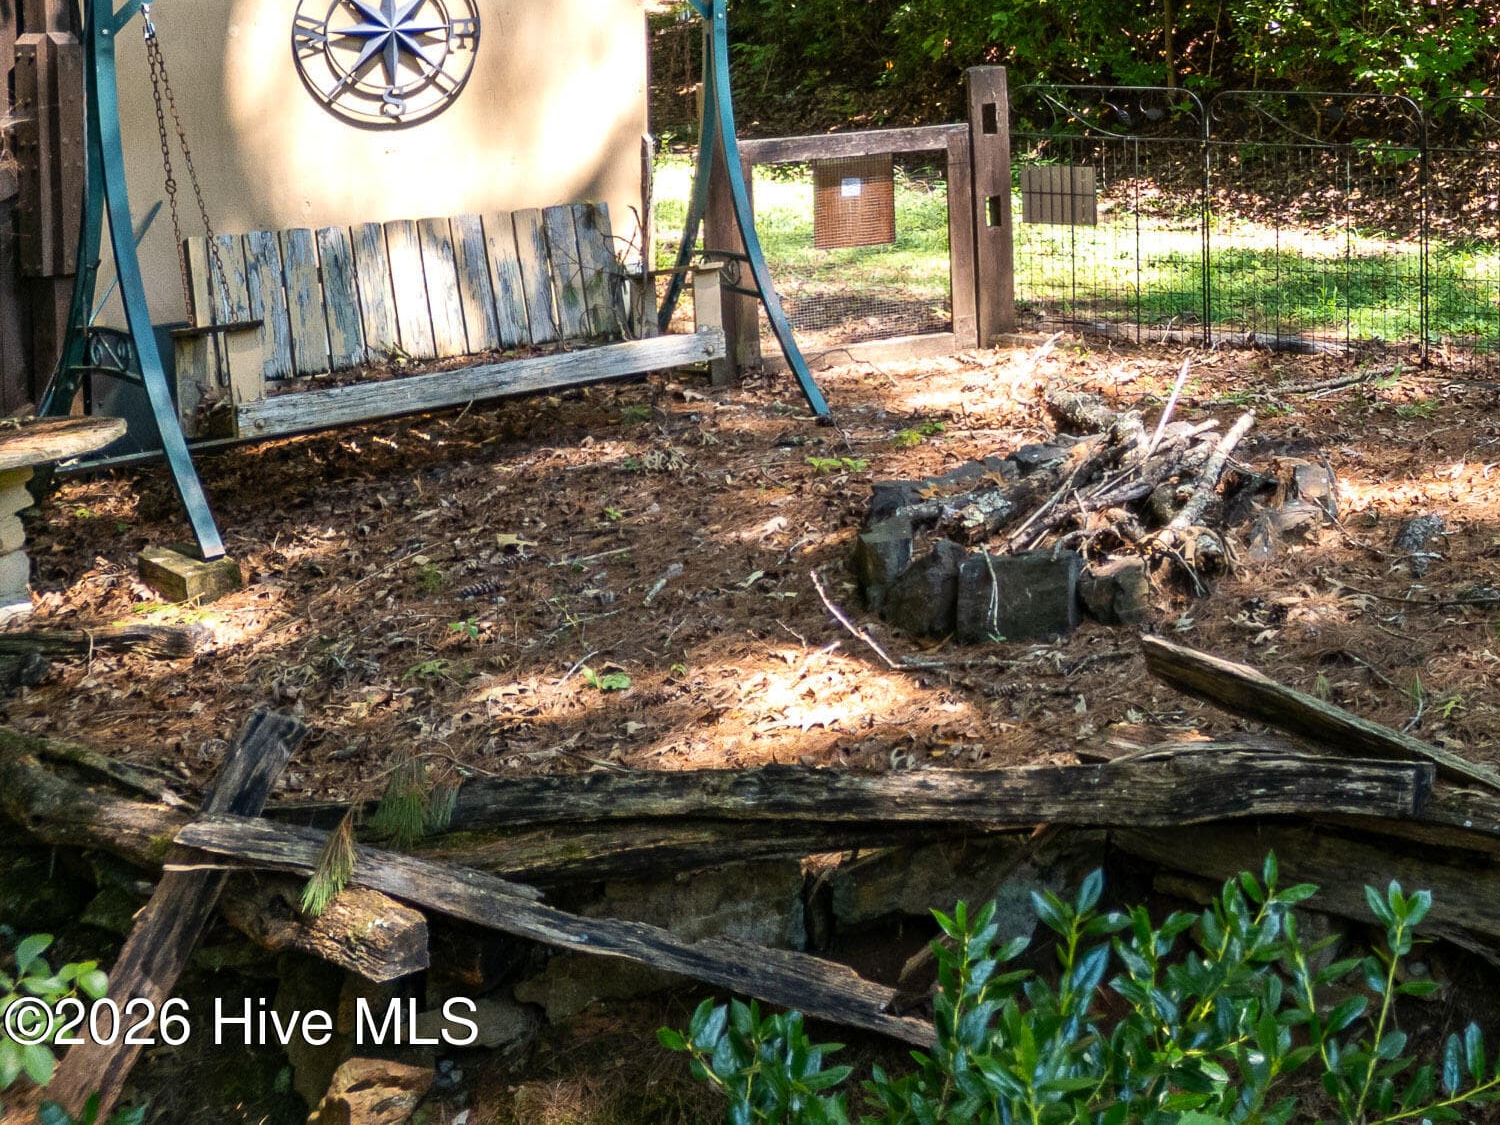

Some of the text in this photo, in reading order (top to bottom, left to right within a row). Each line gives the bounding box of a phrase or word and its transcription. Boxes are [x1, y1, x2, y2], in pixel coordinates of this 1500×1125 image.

[294, 13, 328, 59] W
[447, 17, 481, 54] E
[382, 86, 407, 117] S
